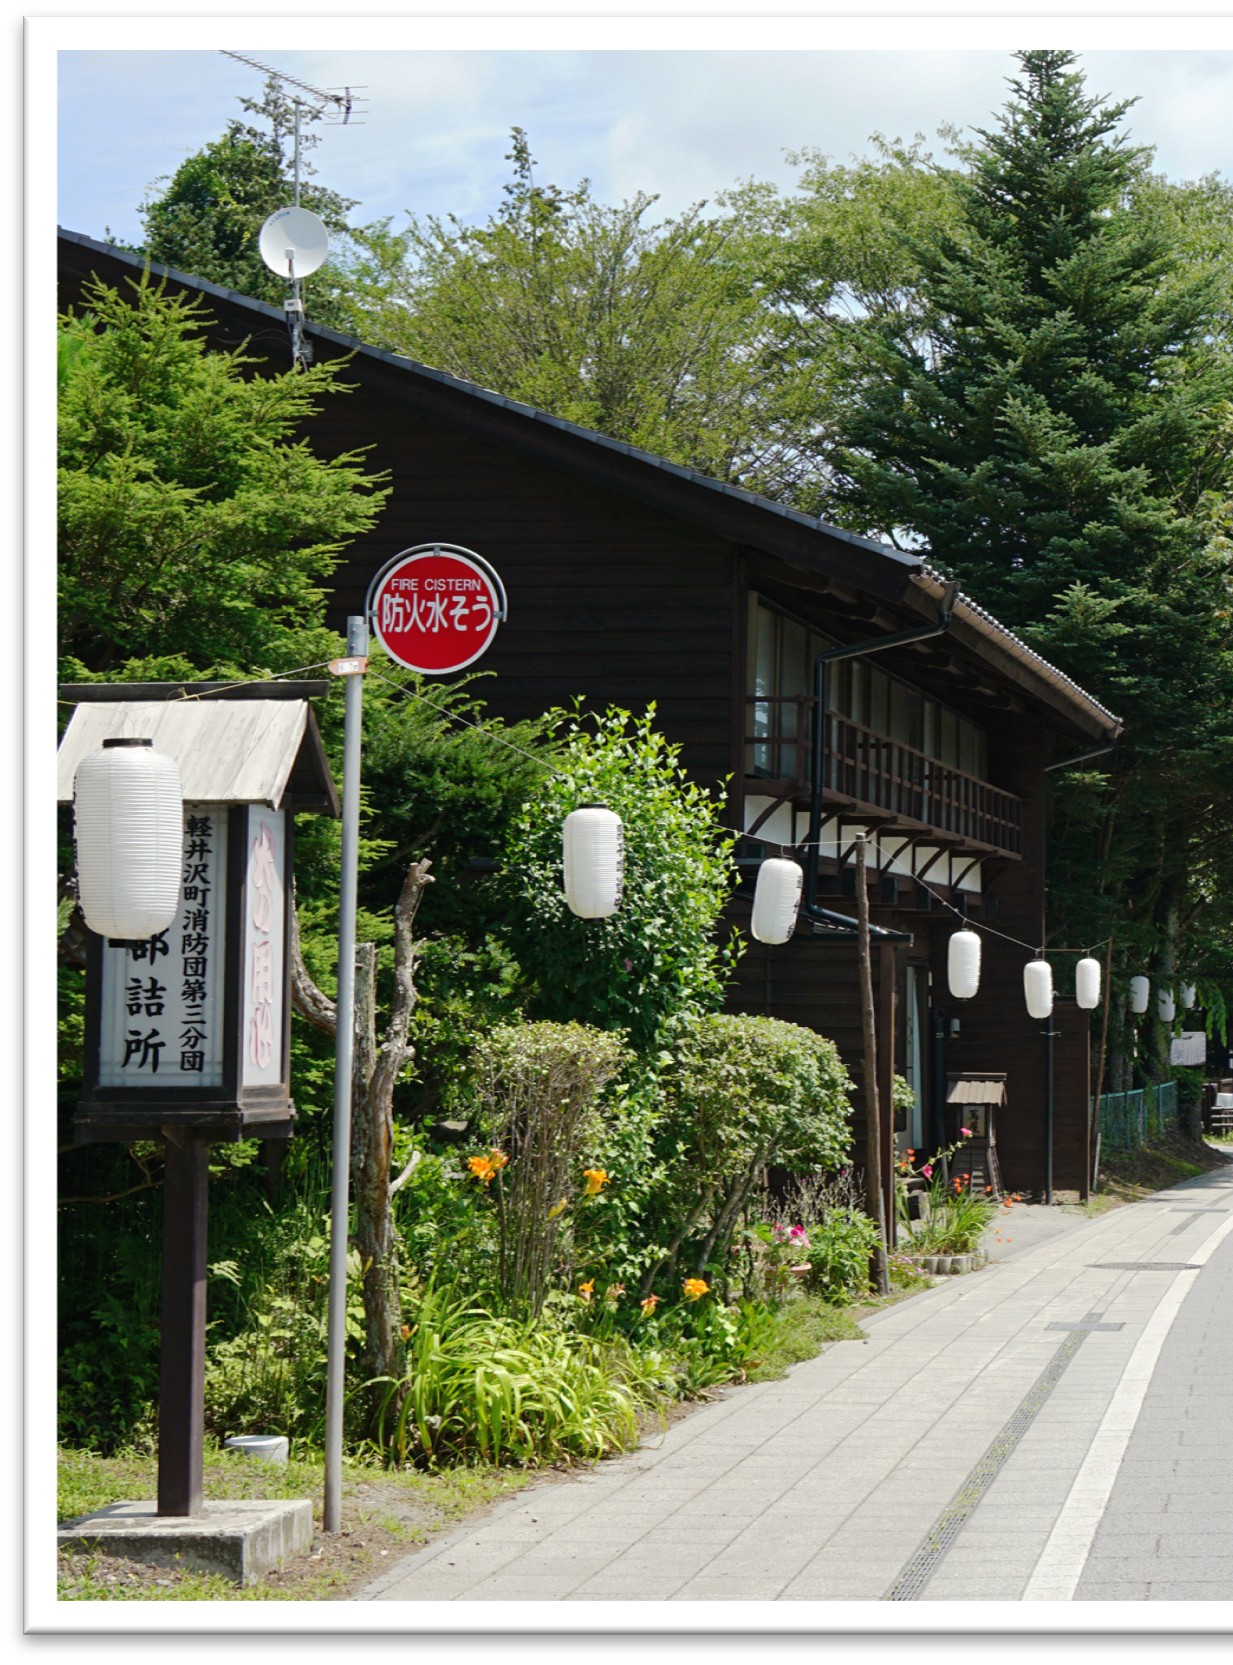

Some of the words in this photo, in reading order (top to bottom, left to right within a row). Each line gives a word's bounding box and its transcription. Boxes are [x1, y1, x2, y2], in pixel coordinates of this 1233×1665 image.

[391, 578, 419, 591] FIRE
[424, 578, 481, 591] CISTERN
[382, 592, 491, 633] 防火水そう
[178, 814, 212, 1073] 軽井沢町消防団第三分団
